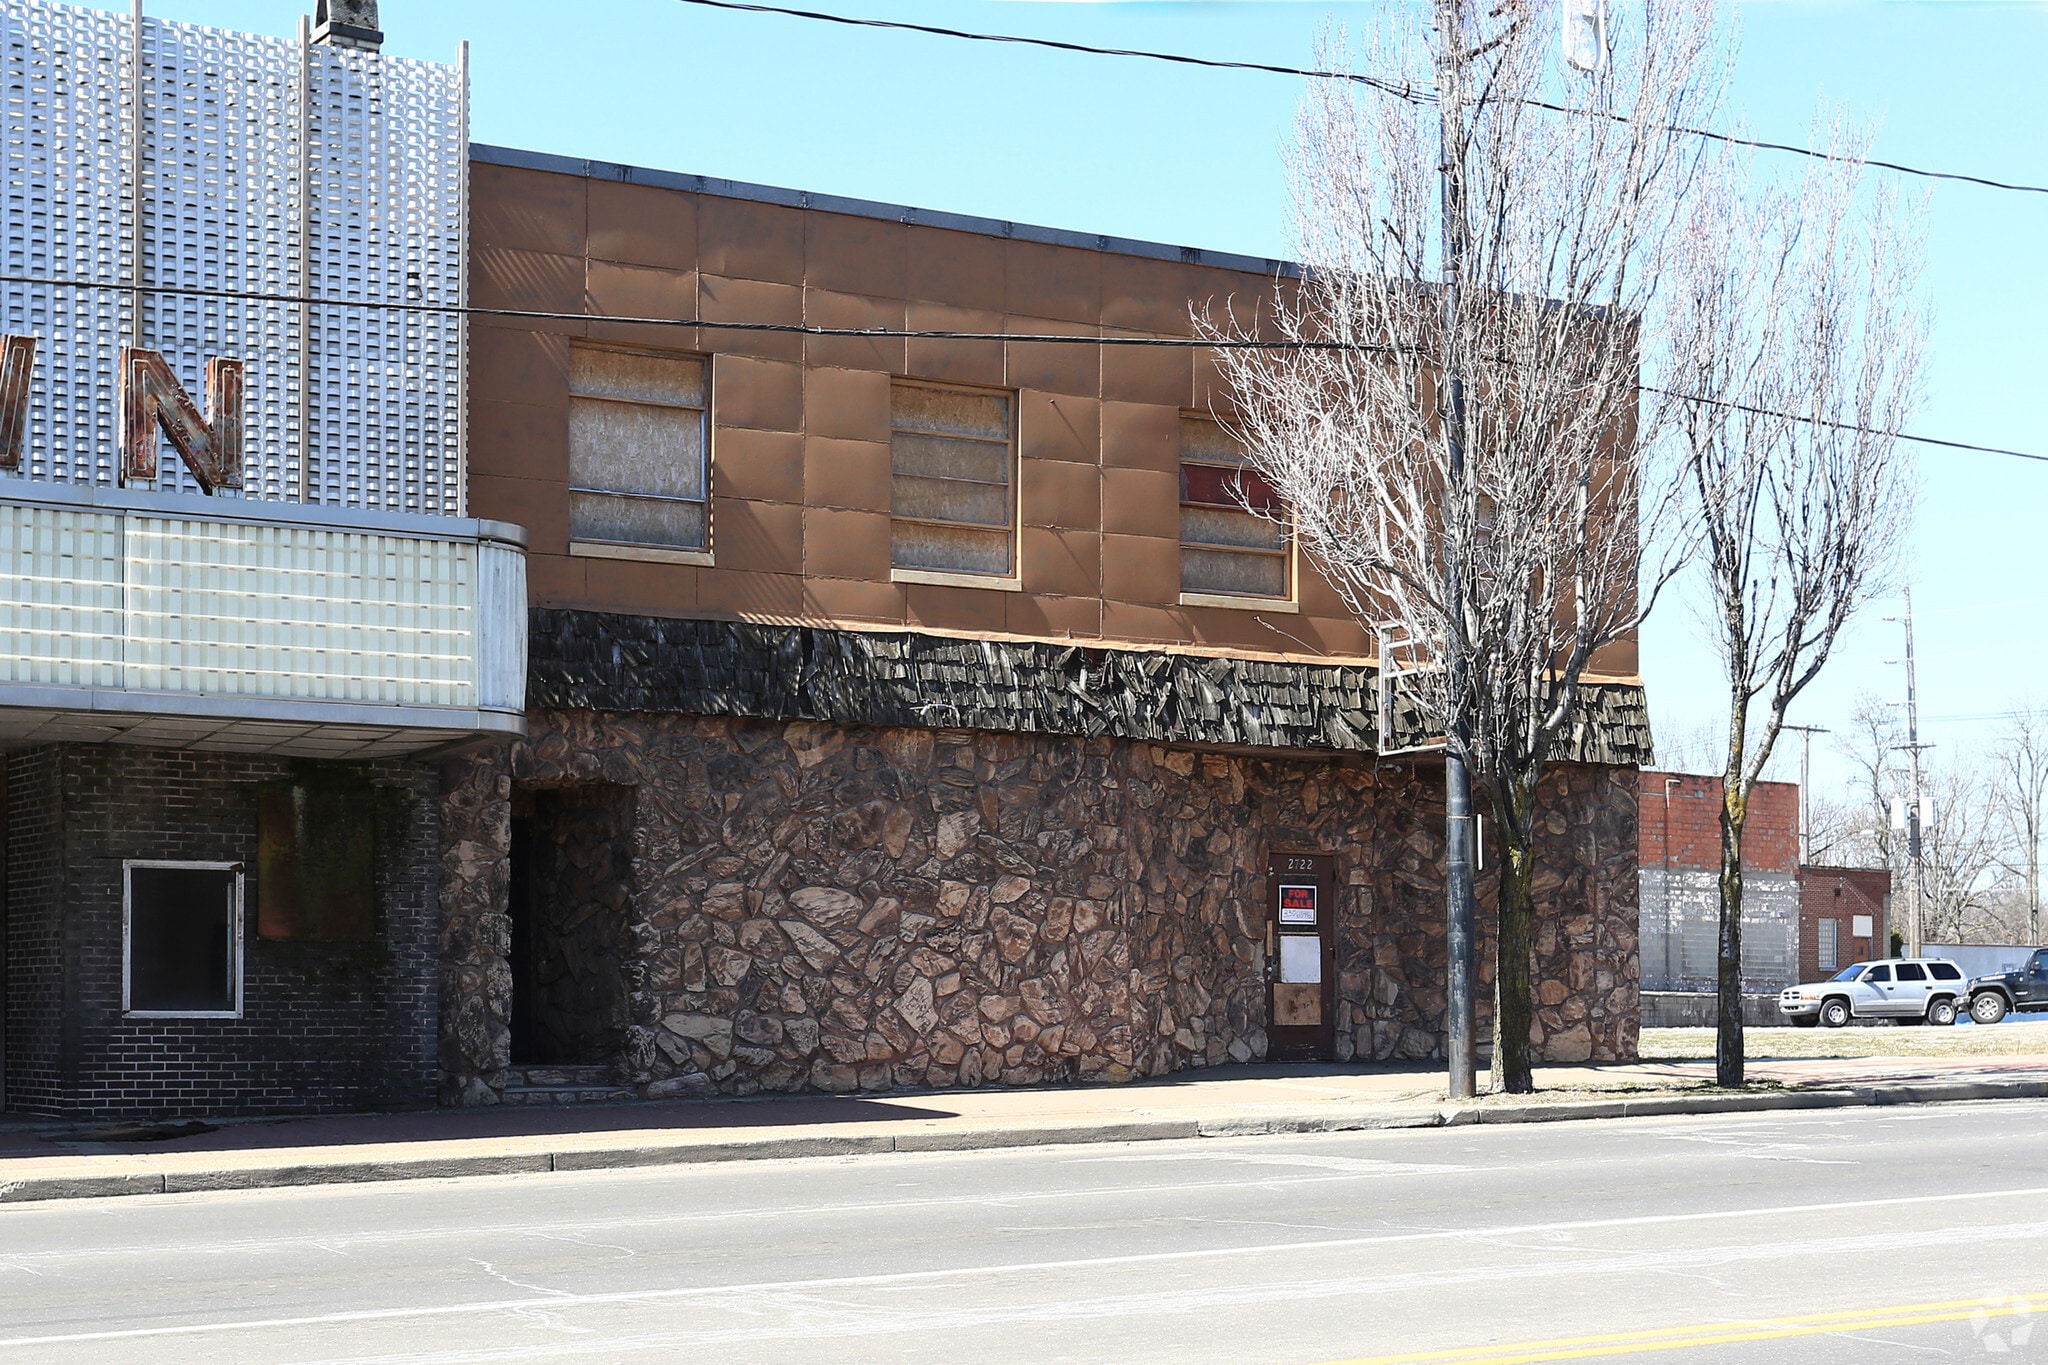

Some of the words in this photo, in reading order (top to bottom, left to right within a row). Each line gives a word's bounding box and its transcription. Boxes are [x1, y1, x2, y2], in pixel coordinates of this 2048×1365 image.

[1288, 858, 1313, 870] 2722
[1288, 889, 1309, 898] FOR
[1283, 898, 1314, 908] SALE
